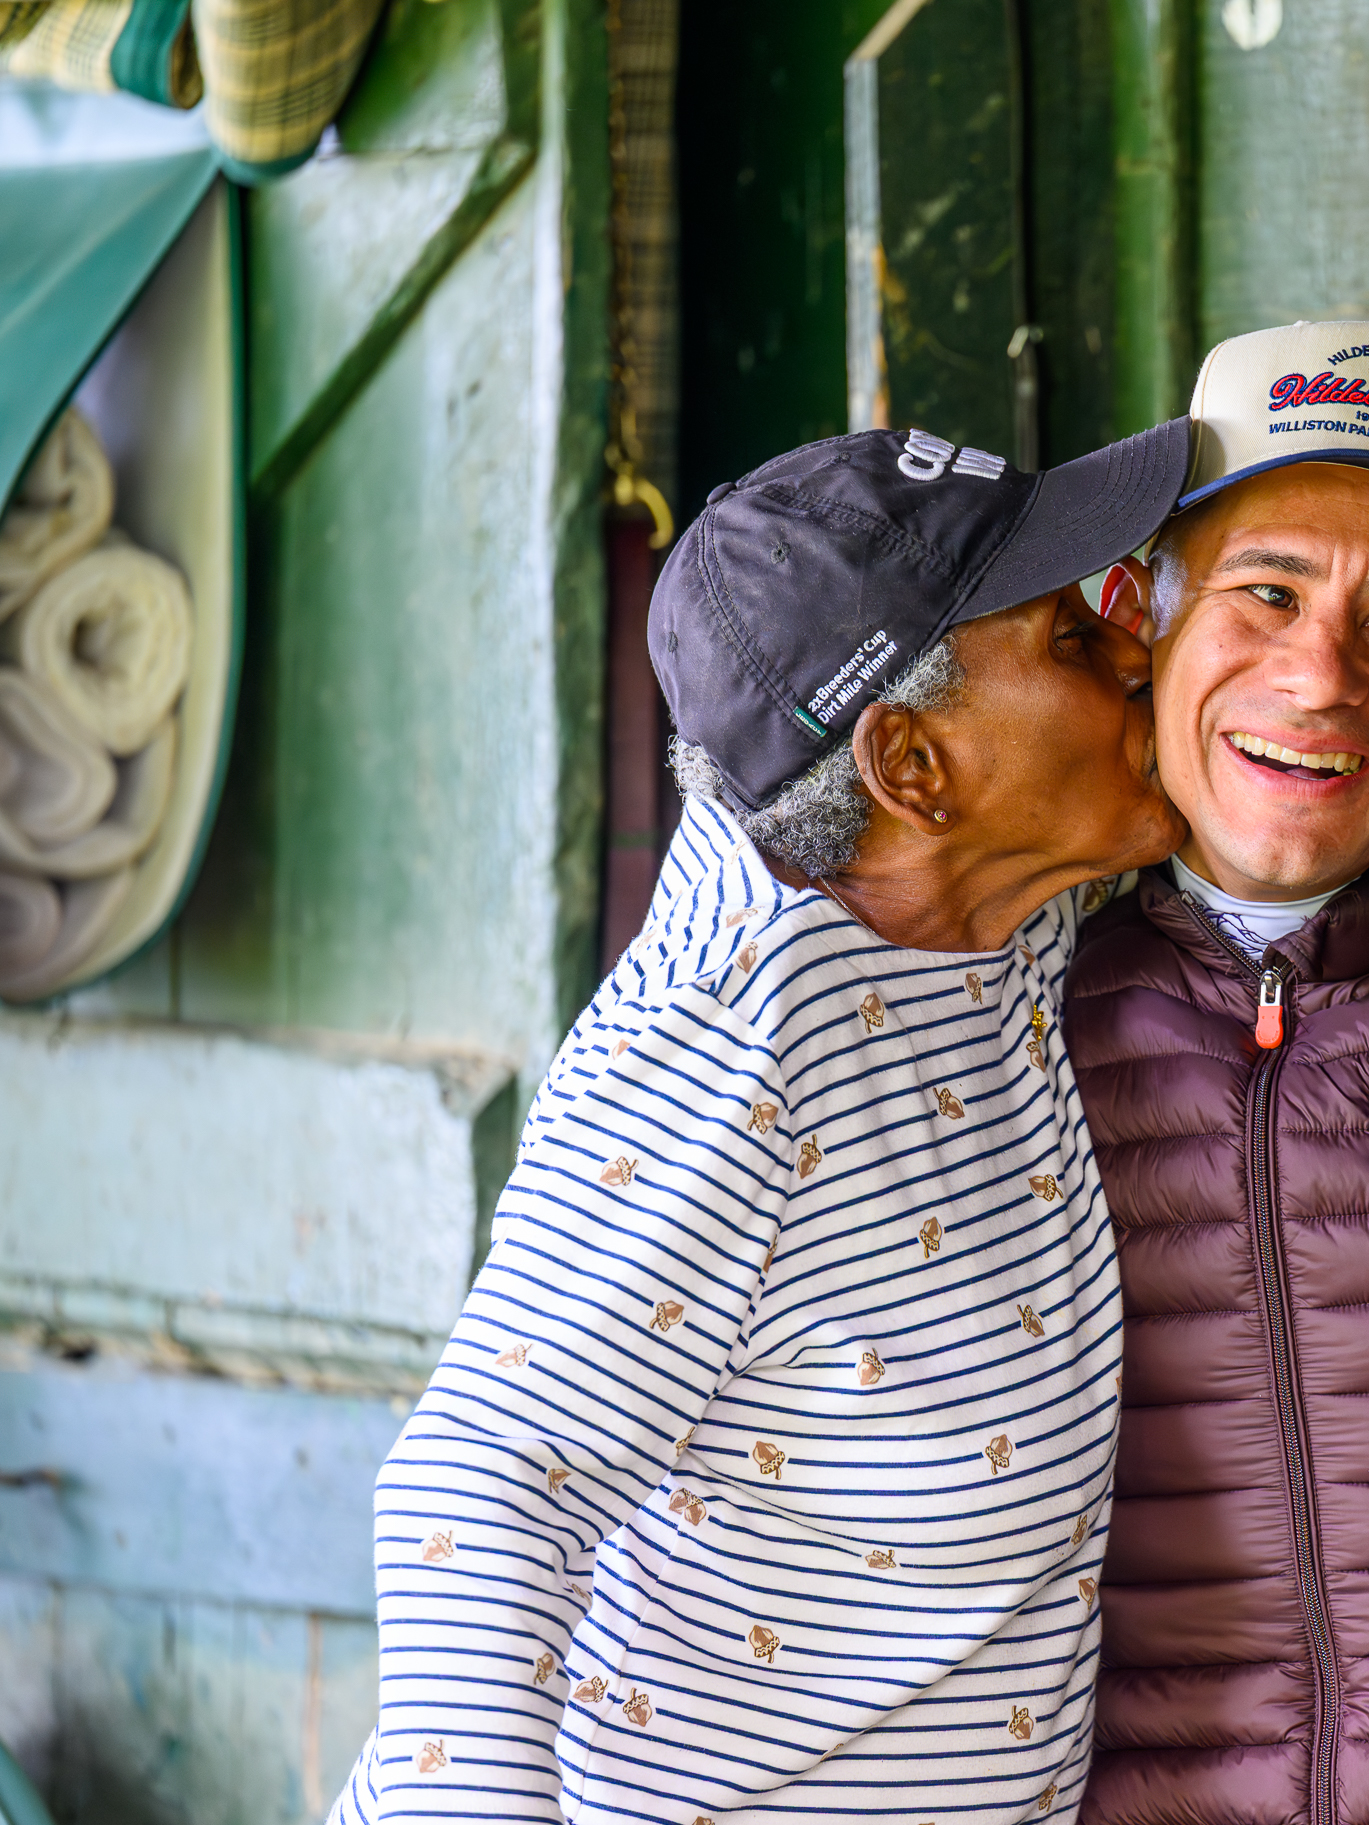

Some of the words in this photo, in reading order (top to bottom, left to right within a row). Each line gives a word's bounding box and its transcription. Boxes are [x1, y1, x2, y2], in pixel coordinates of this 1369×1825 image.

[1268, 420, 1348, 435] WILLISTON
[863, 629, 887, 652] Cup
[816, 699, 842, 725] Dirt
[835, 678, 863, 706] Mile
[856, 640, 898, 681] Winner
[794, 711, 823, 736] LEGACY
